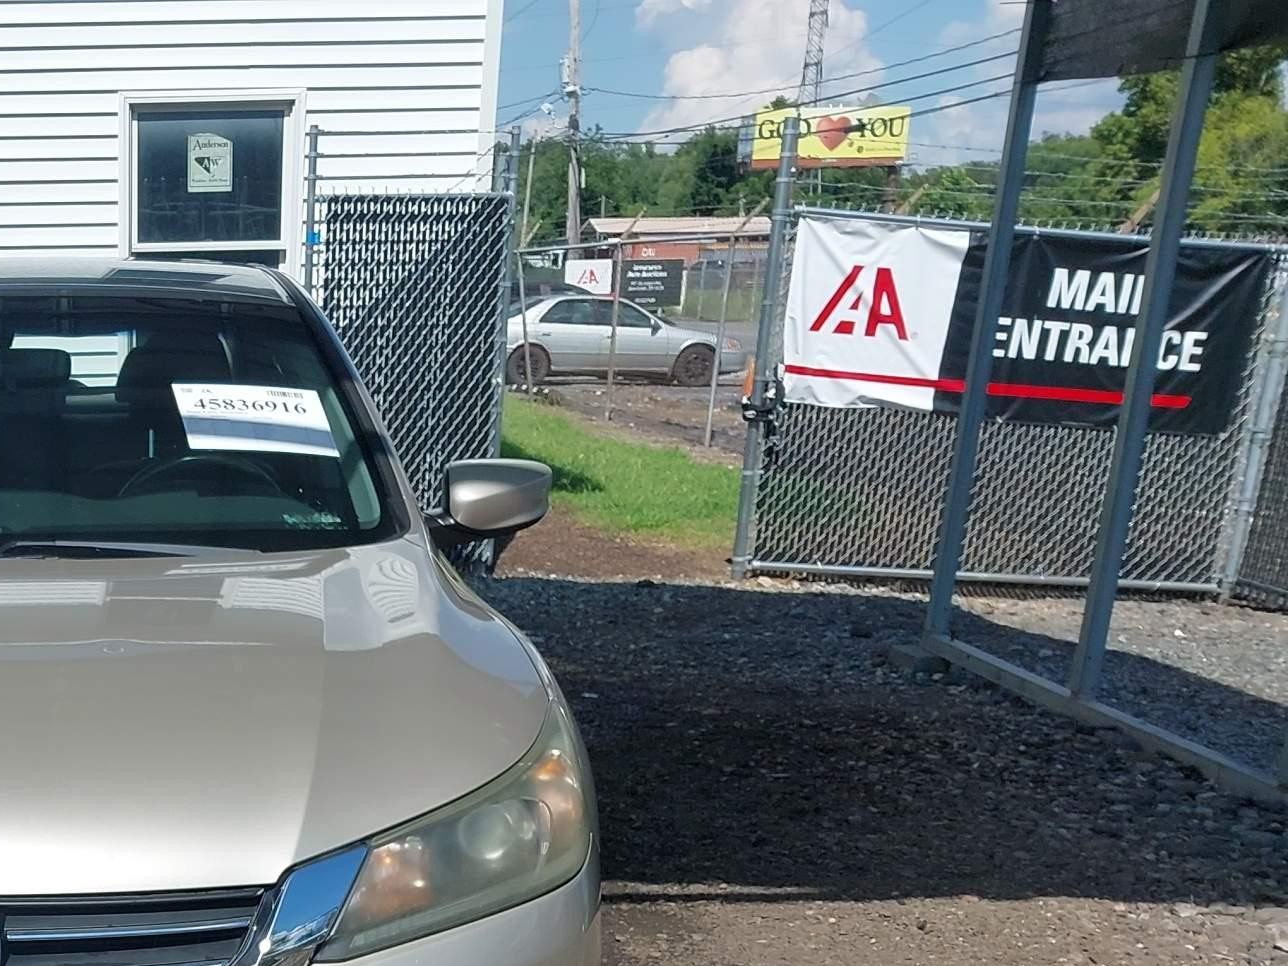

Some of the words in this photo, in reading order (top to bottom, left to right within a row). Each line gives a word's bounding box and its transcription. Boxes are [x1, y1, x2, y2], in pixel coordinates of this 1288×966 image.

[856, 116, 906, 138] YOU
[192, 139, 229, 150] Andersen
[194, 398, 307, 414] 45836916
